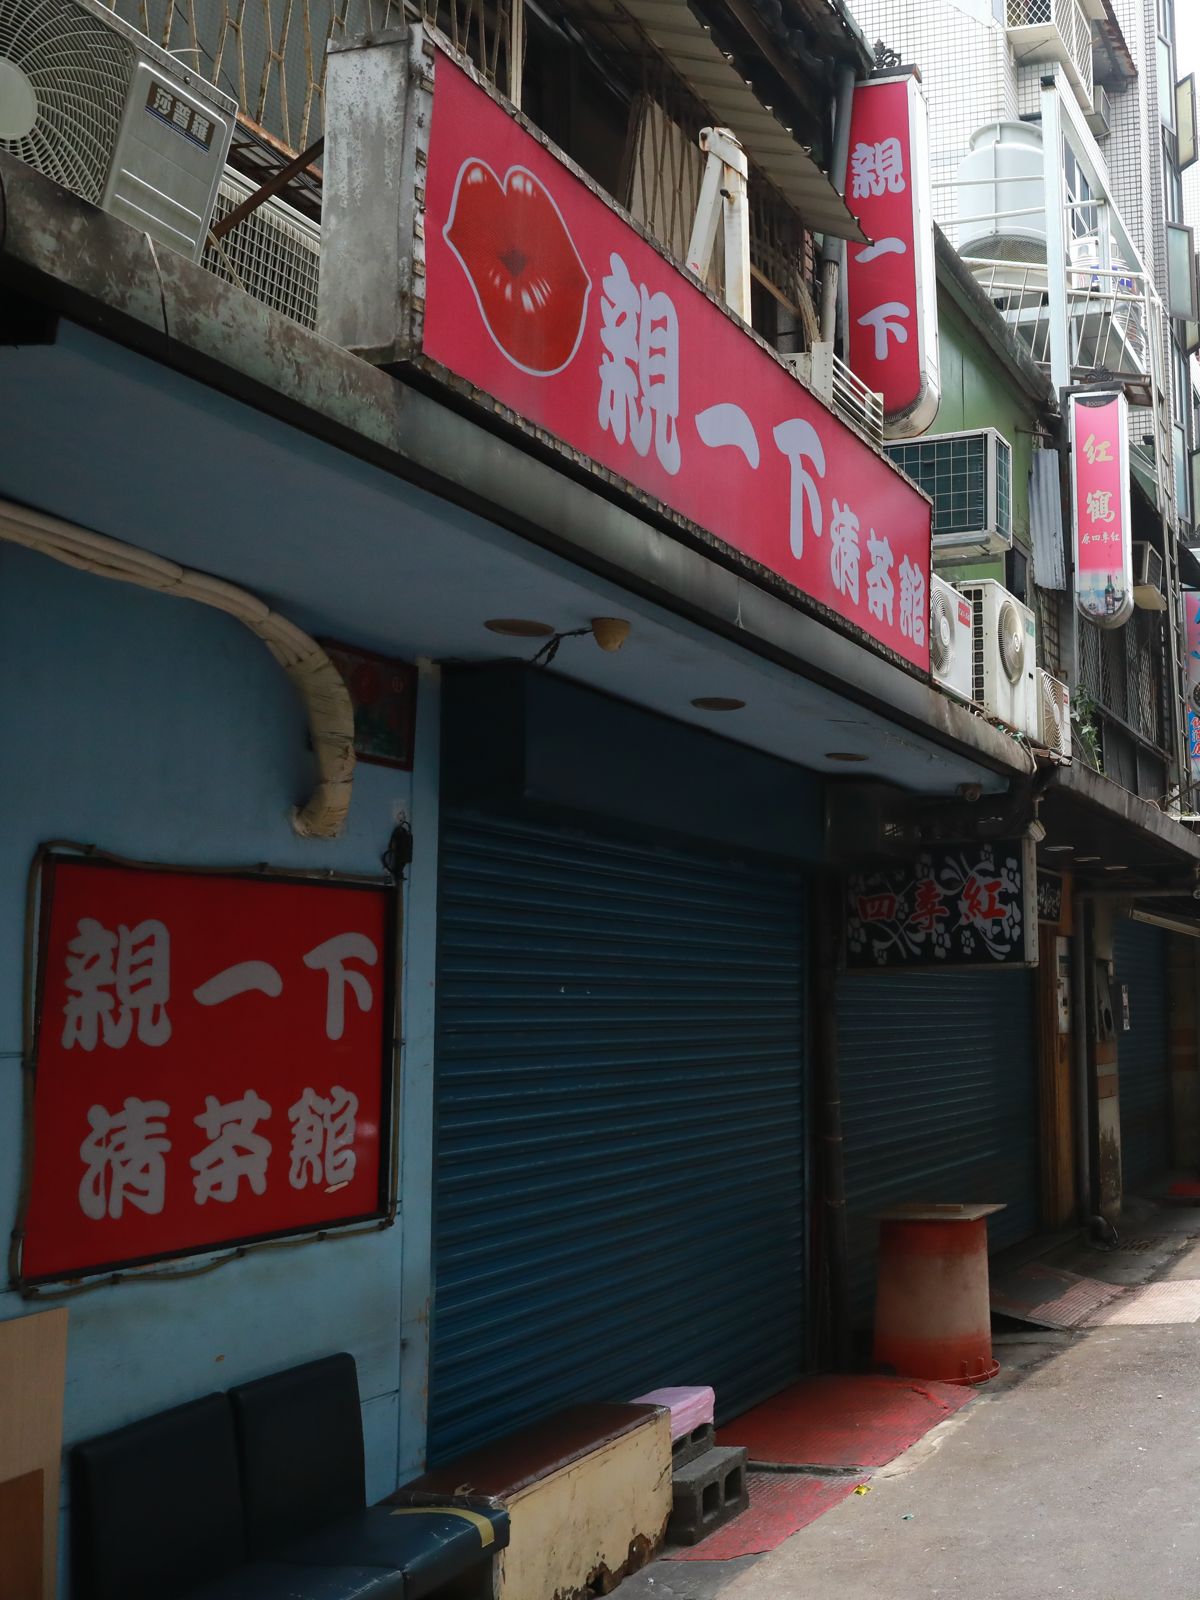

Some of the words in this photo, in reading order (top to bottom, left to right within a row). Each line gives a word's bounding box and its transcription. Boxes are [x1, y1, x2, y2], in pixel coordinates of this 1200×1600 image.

[850, 141, 909, 361] 親一下
[856, 874, 1008, 932] 四季紅
[61, 917, 380, 1052] 親一下
[78, 1085, 360, 1220] 清茶館
